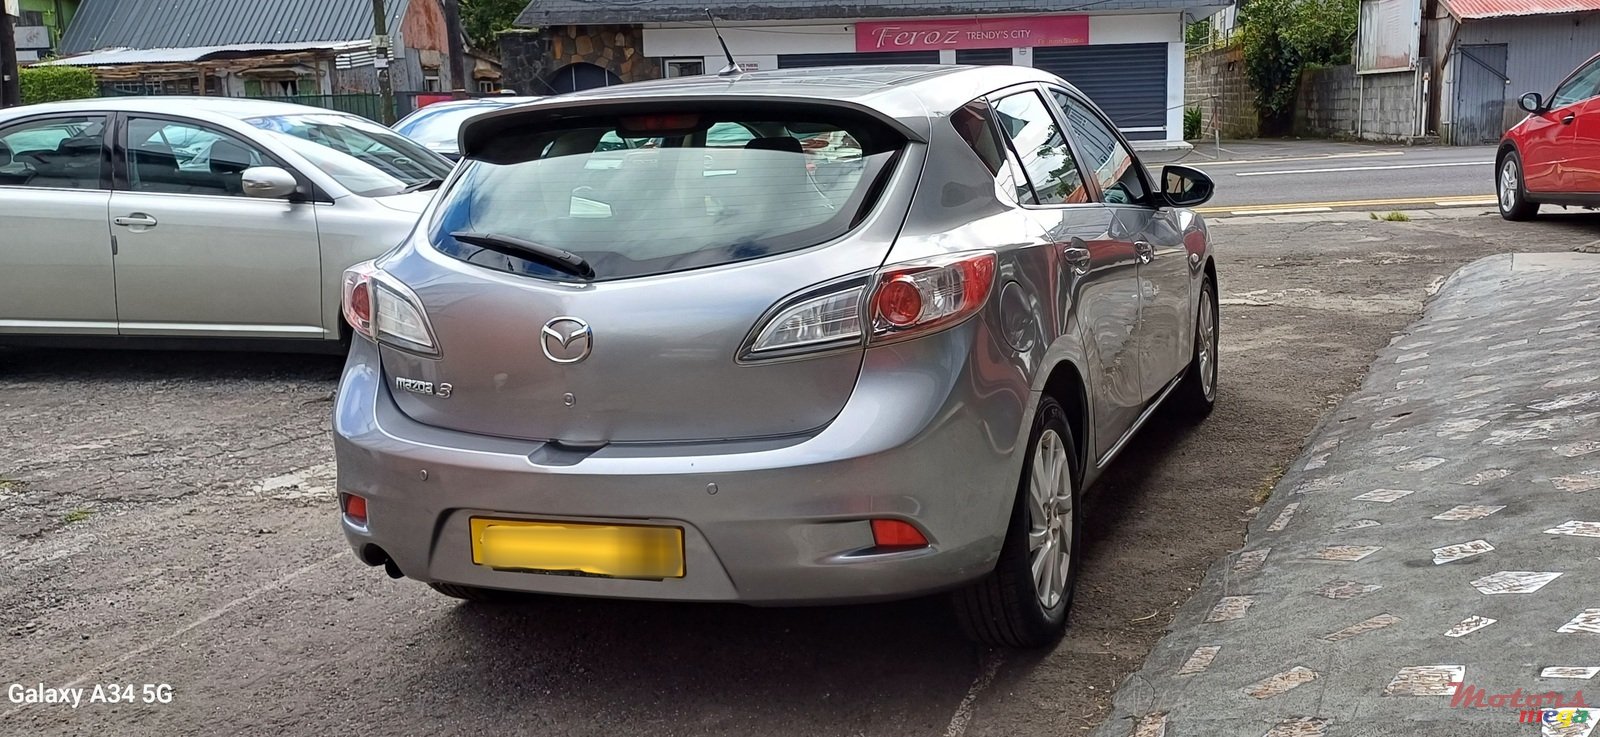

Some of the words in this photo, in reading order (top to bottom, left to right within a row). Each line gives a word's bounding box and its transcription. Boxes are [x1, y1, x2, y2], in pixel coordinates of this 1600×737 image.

[871, 26, 961, 49] Feroz
[966, 30, 1009, 40] TRENDY'S
[1010, 29, 1031, 39] CITY
[436, 382, 453, 399] 3
